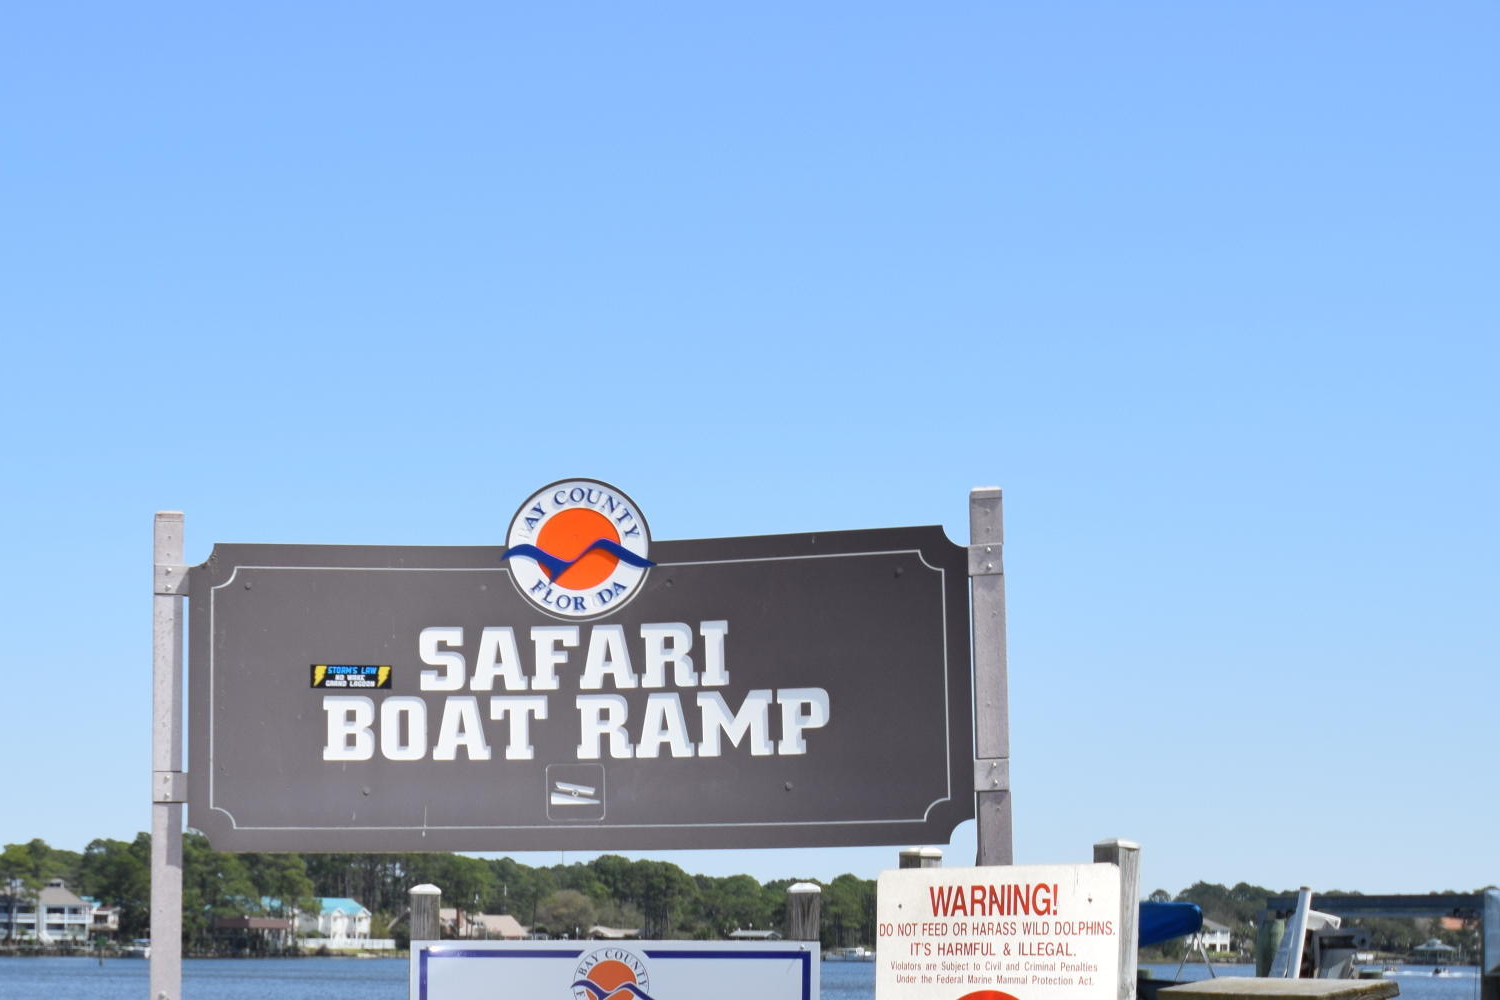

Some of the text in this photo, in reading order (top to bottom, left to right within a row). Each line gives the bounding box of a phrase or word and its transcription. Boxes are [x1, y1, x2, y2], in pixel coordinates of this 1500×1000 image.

[554, 488, 639, 537] COUNTY
[530, 579, 627, 611] FLORDA
[419, 620, 729, 691] SAFARI
[322, 686, 830, 762] BOAT RAMP
[930, 883, 1059, 917] WARNING!
[879, 921, 1116, 937] DO NOT FEED OR HARASS WILD DOLPHINS.
[910, 942, 1076, 956] IT'S HARMFUL & ILLEGAL.
[578, 950, 646, 985] BAY COUNTY
[891, 961, 1098, 973] Violators are Subject to Civil and Criminal Penalties
[896, 974, 1094, 986] Under the Federal Marine Mammal Protection Act.
